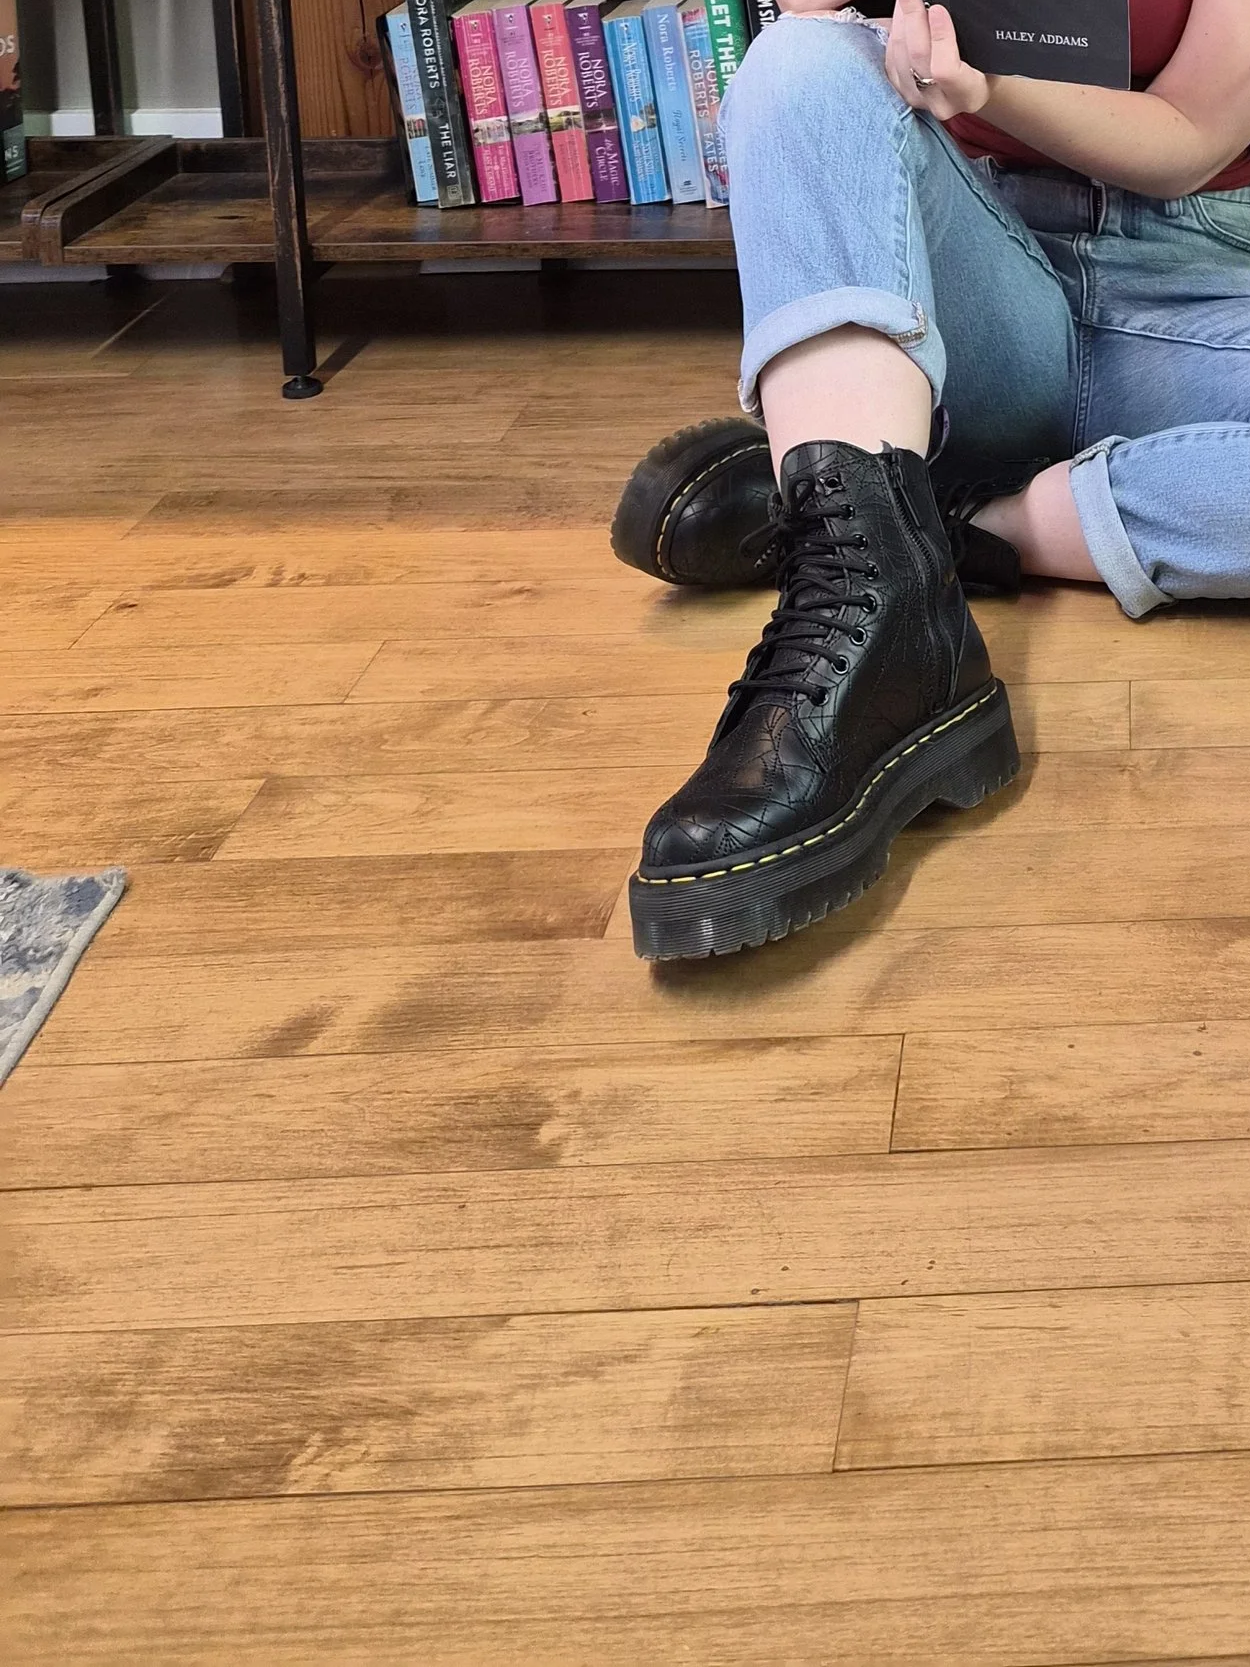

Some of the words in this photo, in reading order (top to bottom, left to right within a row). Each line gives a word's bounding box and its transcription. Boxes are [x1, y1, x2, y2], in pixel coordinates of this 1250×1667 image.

[996, 30, 1035, 42] HALEY
[1039, 35, 1088, 48] ADDAMS
[421, 32, 440, 89] ROBERTS
[442, 150, 456, 179] LIAR
